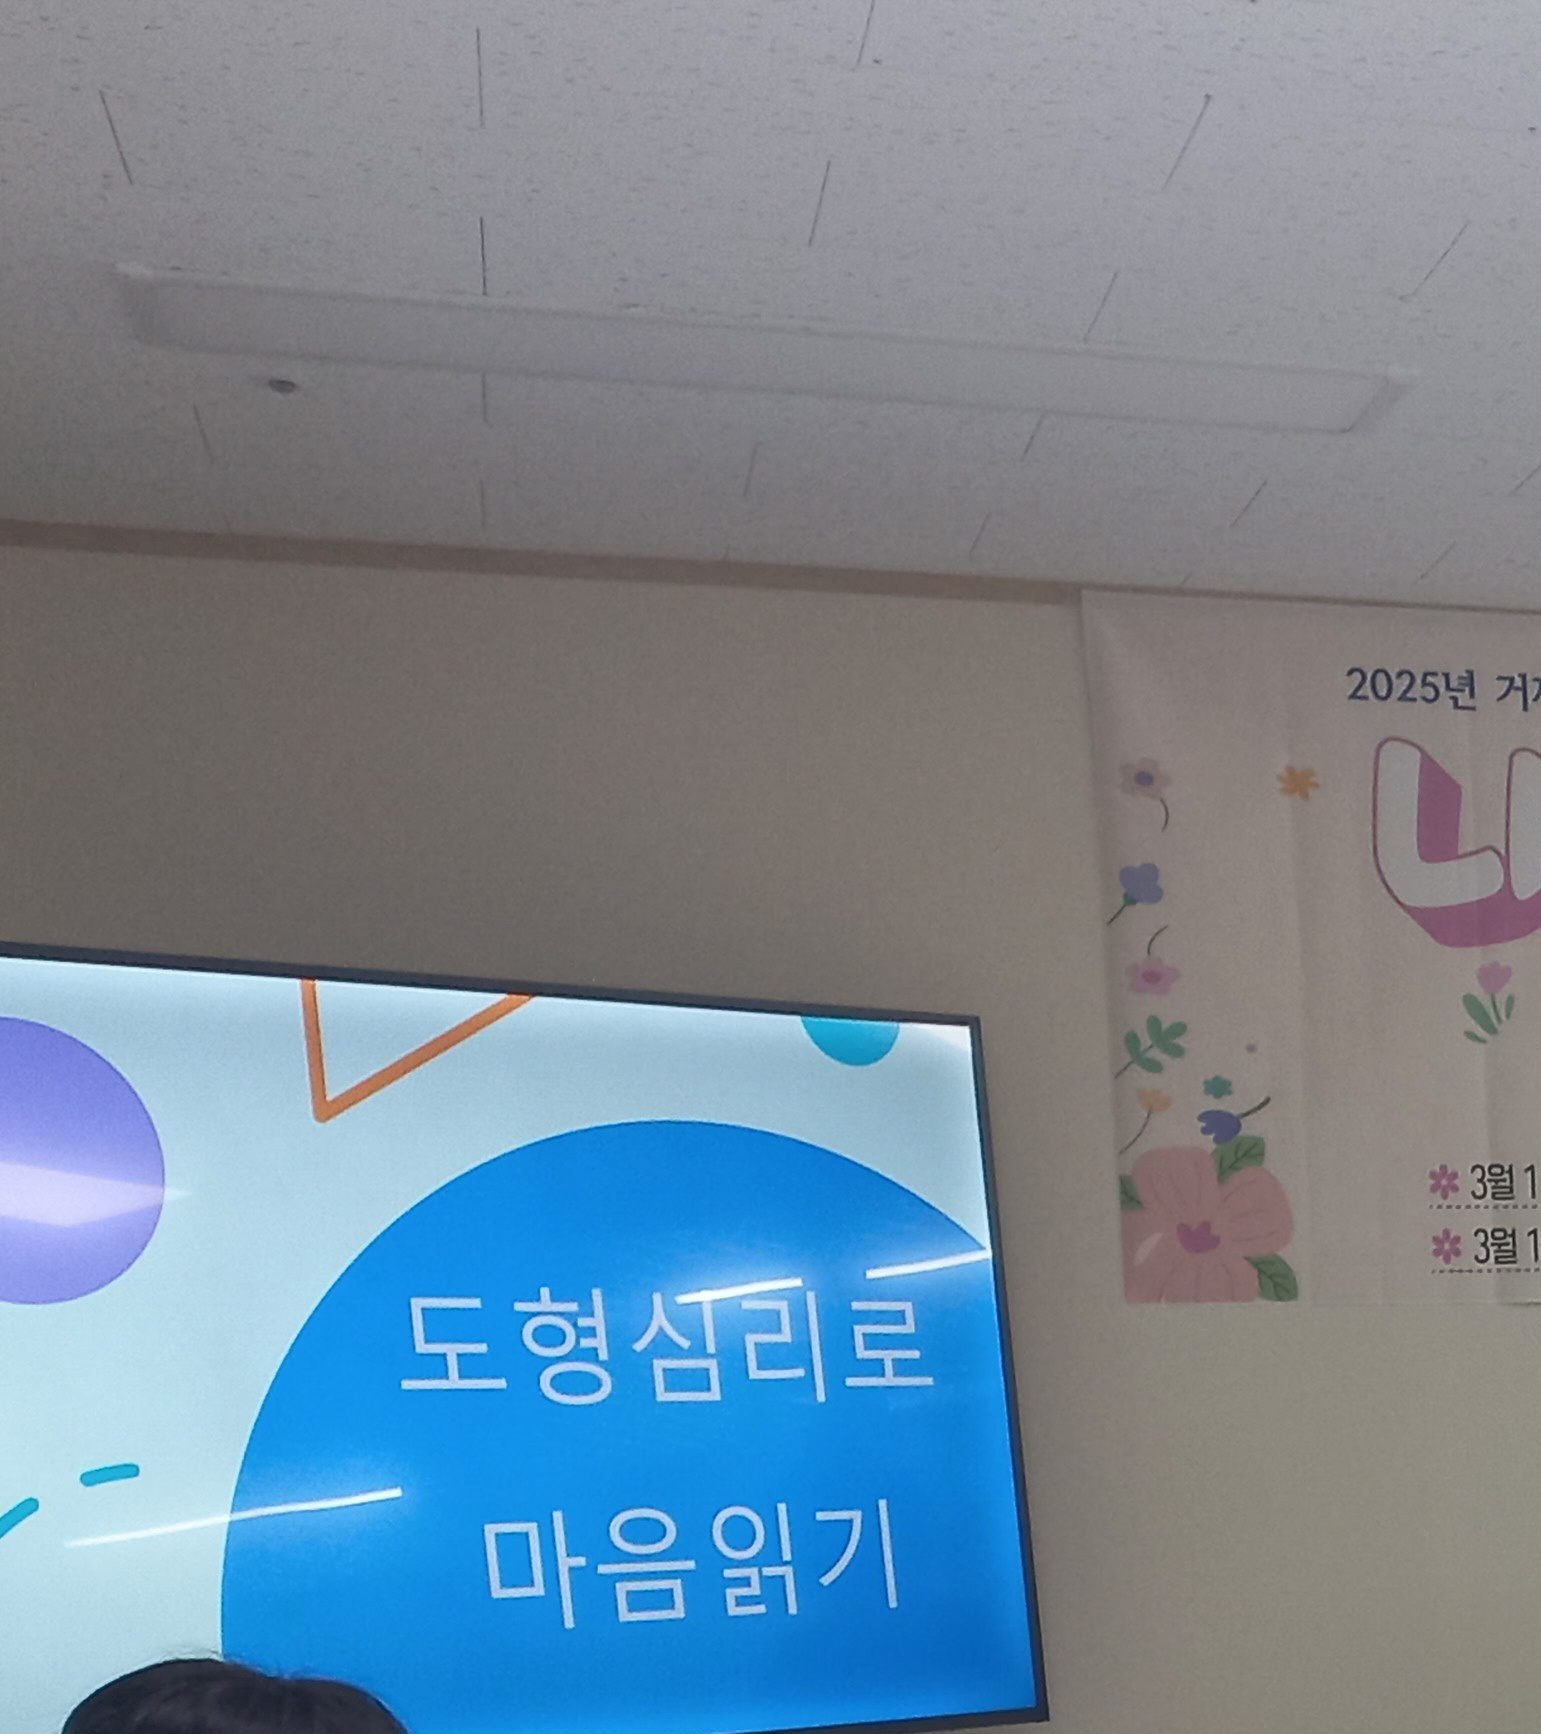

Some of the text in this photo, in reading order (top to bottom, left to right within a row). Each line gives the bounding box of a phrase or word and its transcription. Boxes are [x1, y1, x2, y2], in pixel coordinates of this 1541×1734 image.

[1346, 667, 1477, 712] 2025년
[1470, 1163, 1516, 1201] 3월
[1473, 1227, 1518, 1265] 3월
[400, 1286, 936, 1406] 도형심리로
[484, 1498, 898, 1629] 마음읽기
